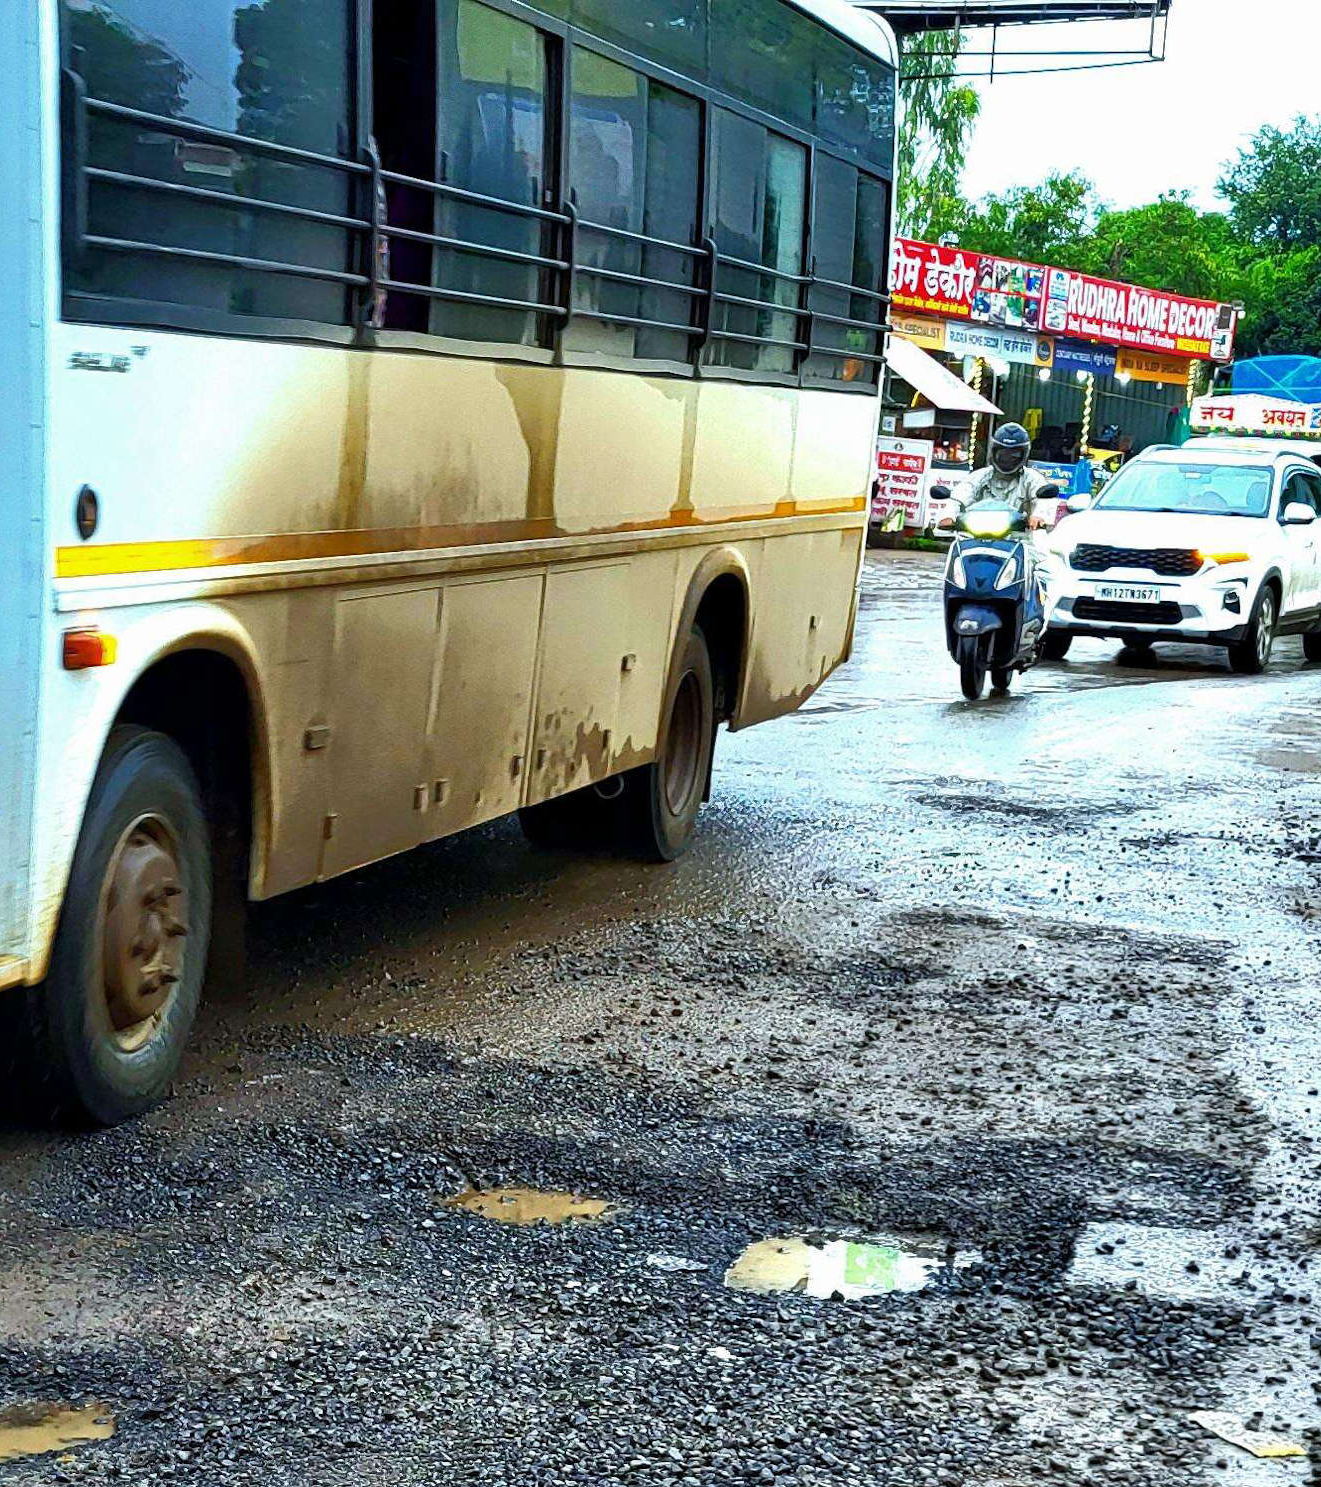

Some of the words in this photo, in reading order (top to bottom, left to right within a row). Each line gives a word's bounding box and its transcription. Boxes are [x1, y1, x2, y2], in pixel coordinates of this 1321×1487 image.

[1067, 278, 1126, 325] RUDHRA
[1126, 292, 1169, 332] HOME
[1168, 301, 1216, 339] DECOR
